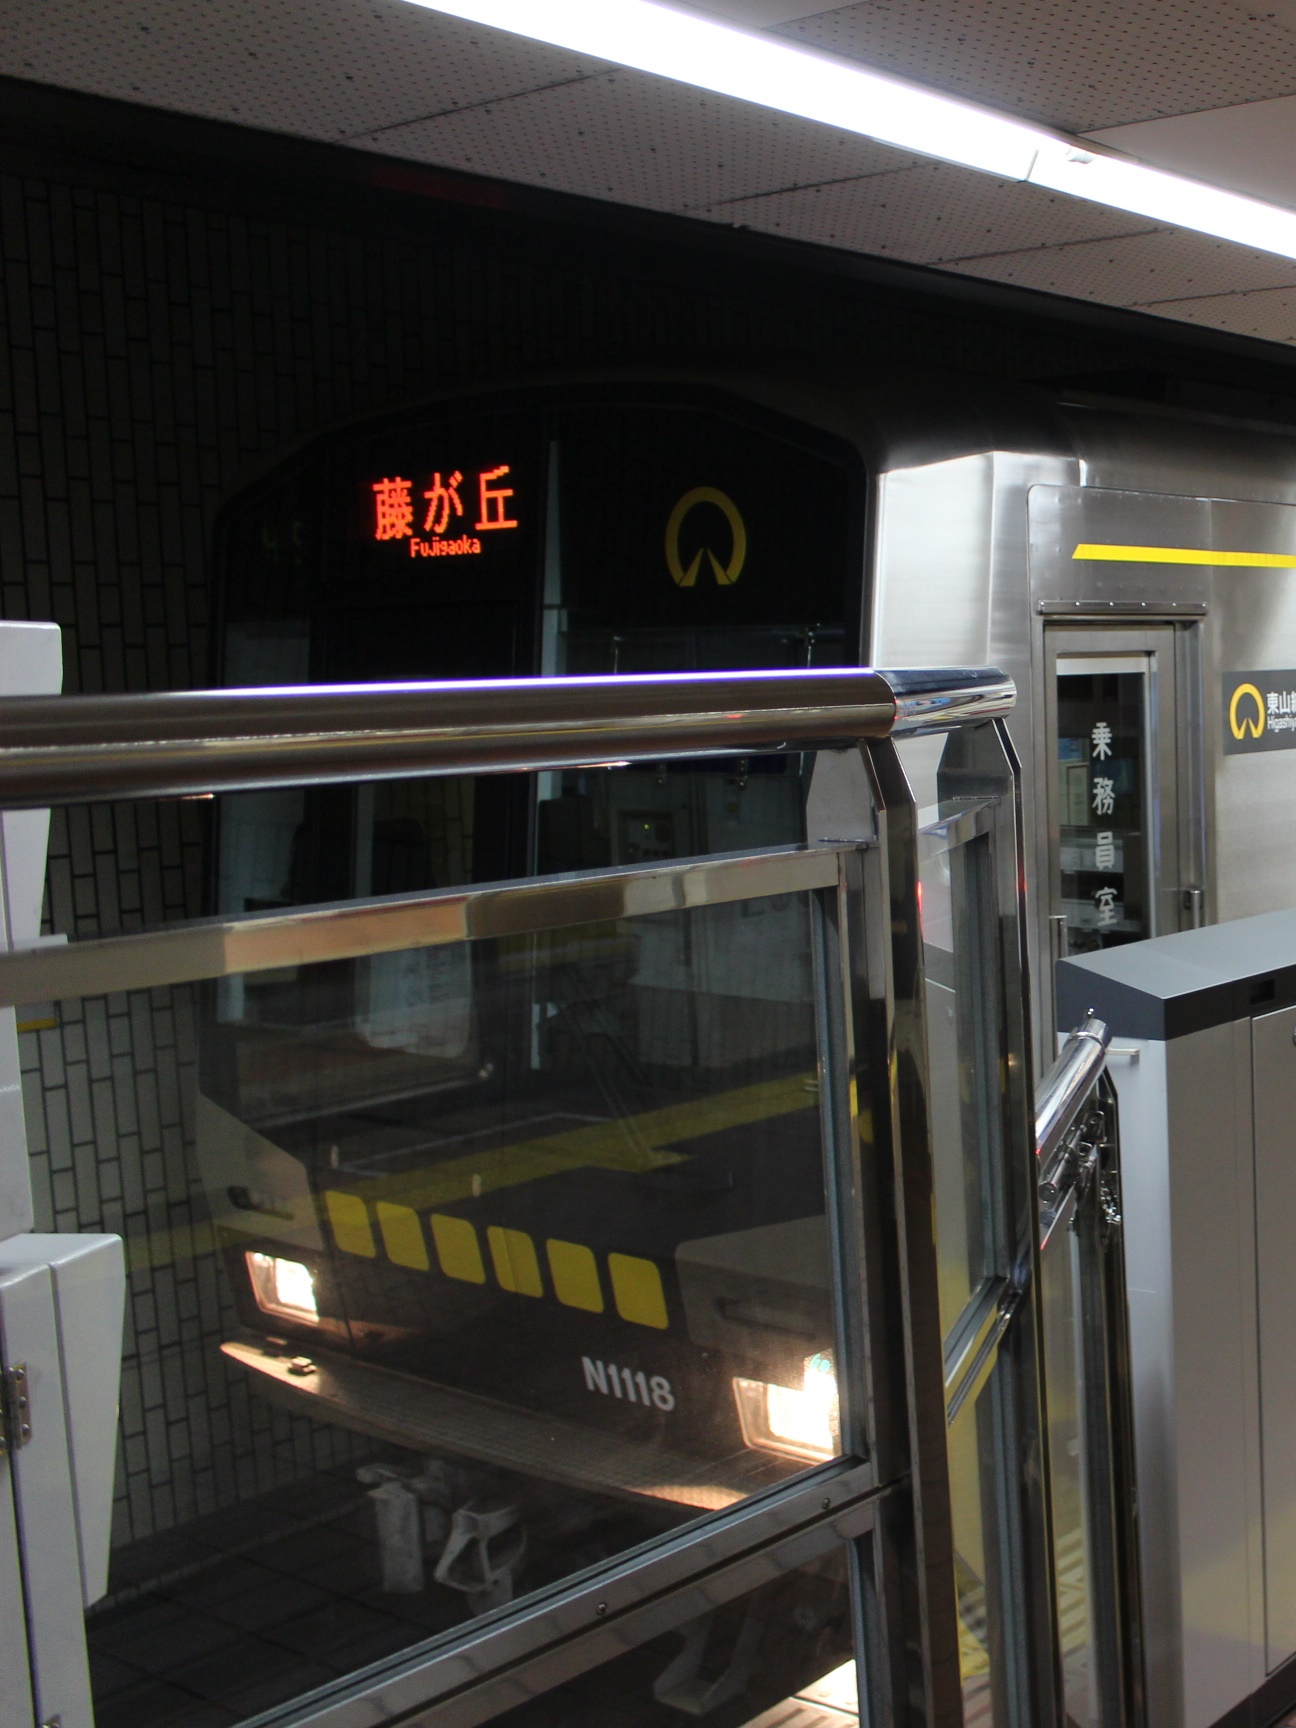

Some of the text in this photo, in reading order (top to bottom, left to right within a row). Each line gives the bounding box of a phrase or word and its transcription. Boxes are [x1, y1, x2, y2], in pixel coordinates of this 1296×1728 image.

[373, 465, 518, 540] 藤が丘
[410, 534, 481, 558] Fujigaoka
[1092, 722, 1118, 926] 乗務員室
[581, 1356, 675, 1412] N1118
